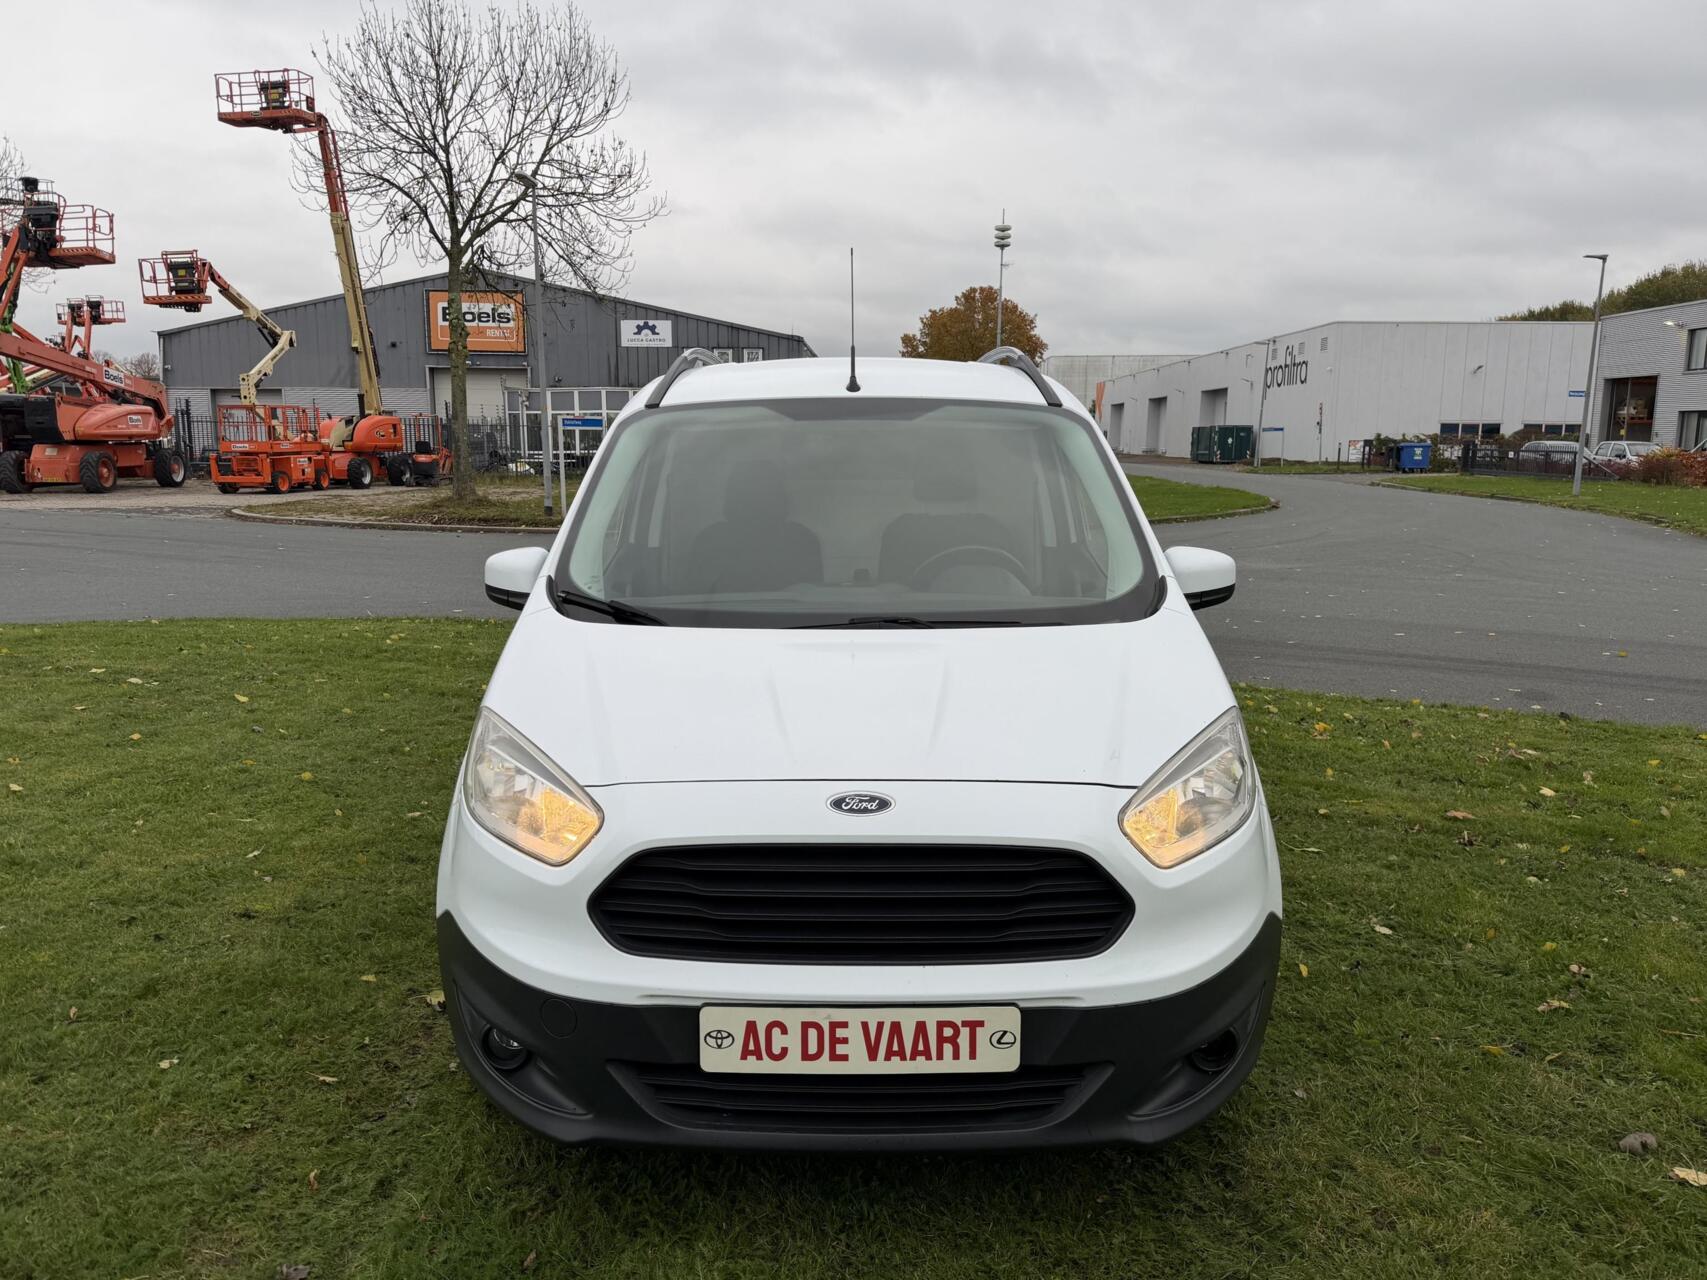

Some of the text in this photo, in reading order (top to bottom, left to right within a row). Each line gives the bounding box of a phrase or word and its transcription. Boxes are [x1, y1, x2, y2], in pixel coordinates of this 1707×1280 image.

[1264, 345, 1308, 400] profiltra
[842, 796, 879, 809] Ford
[739, 1020, 985, 1061] AC DE VAART
